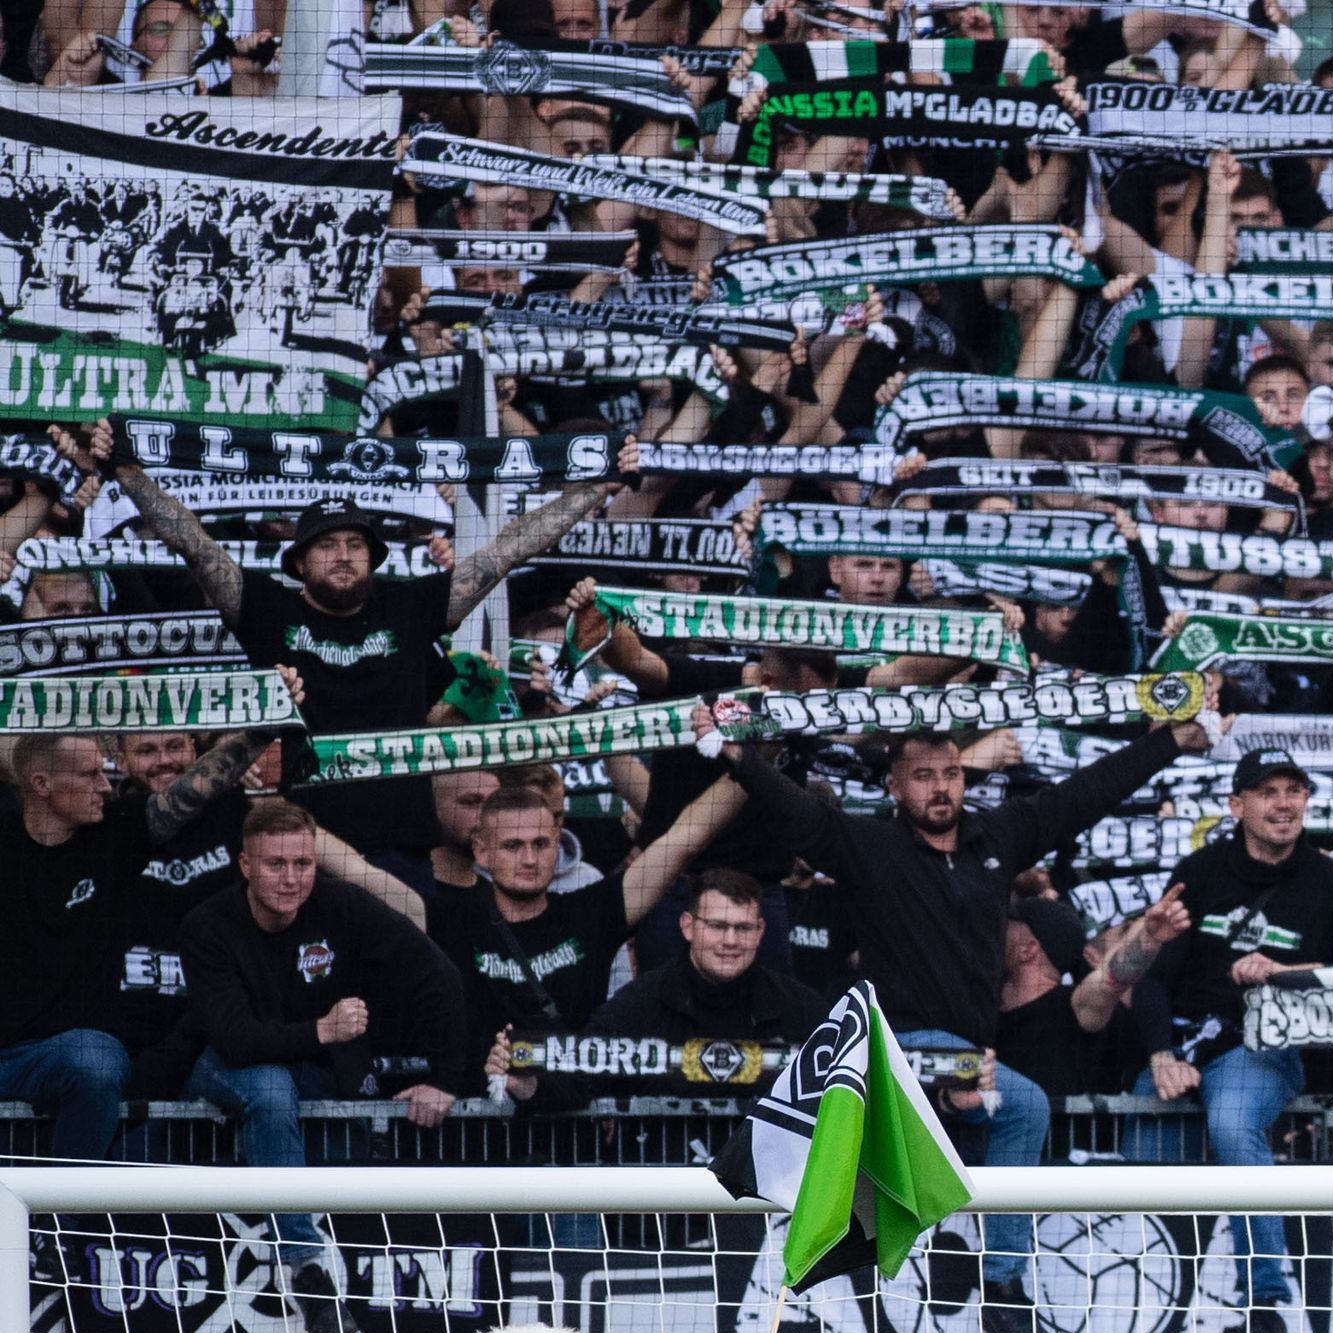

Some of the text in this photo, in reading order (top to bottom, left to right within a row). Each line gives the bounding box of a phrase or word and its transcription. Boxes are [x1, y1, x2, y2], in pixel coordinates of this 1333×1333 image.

[885, 90, 1082, 138] M'GLADBAC
[455, 240, 547, 262] 1900
[126, 419, 610, 483] ULTRAS
[639, 443, 896, 486] RBYSIEGER
[1184, 471, 1265, 500] 1900
[6, 673, 295, 729] ADIONVERB
[764, 677, 1141, 733] DERBYSIEGER
[545, 1035, 669, 1076] NORD
